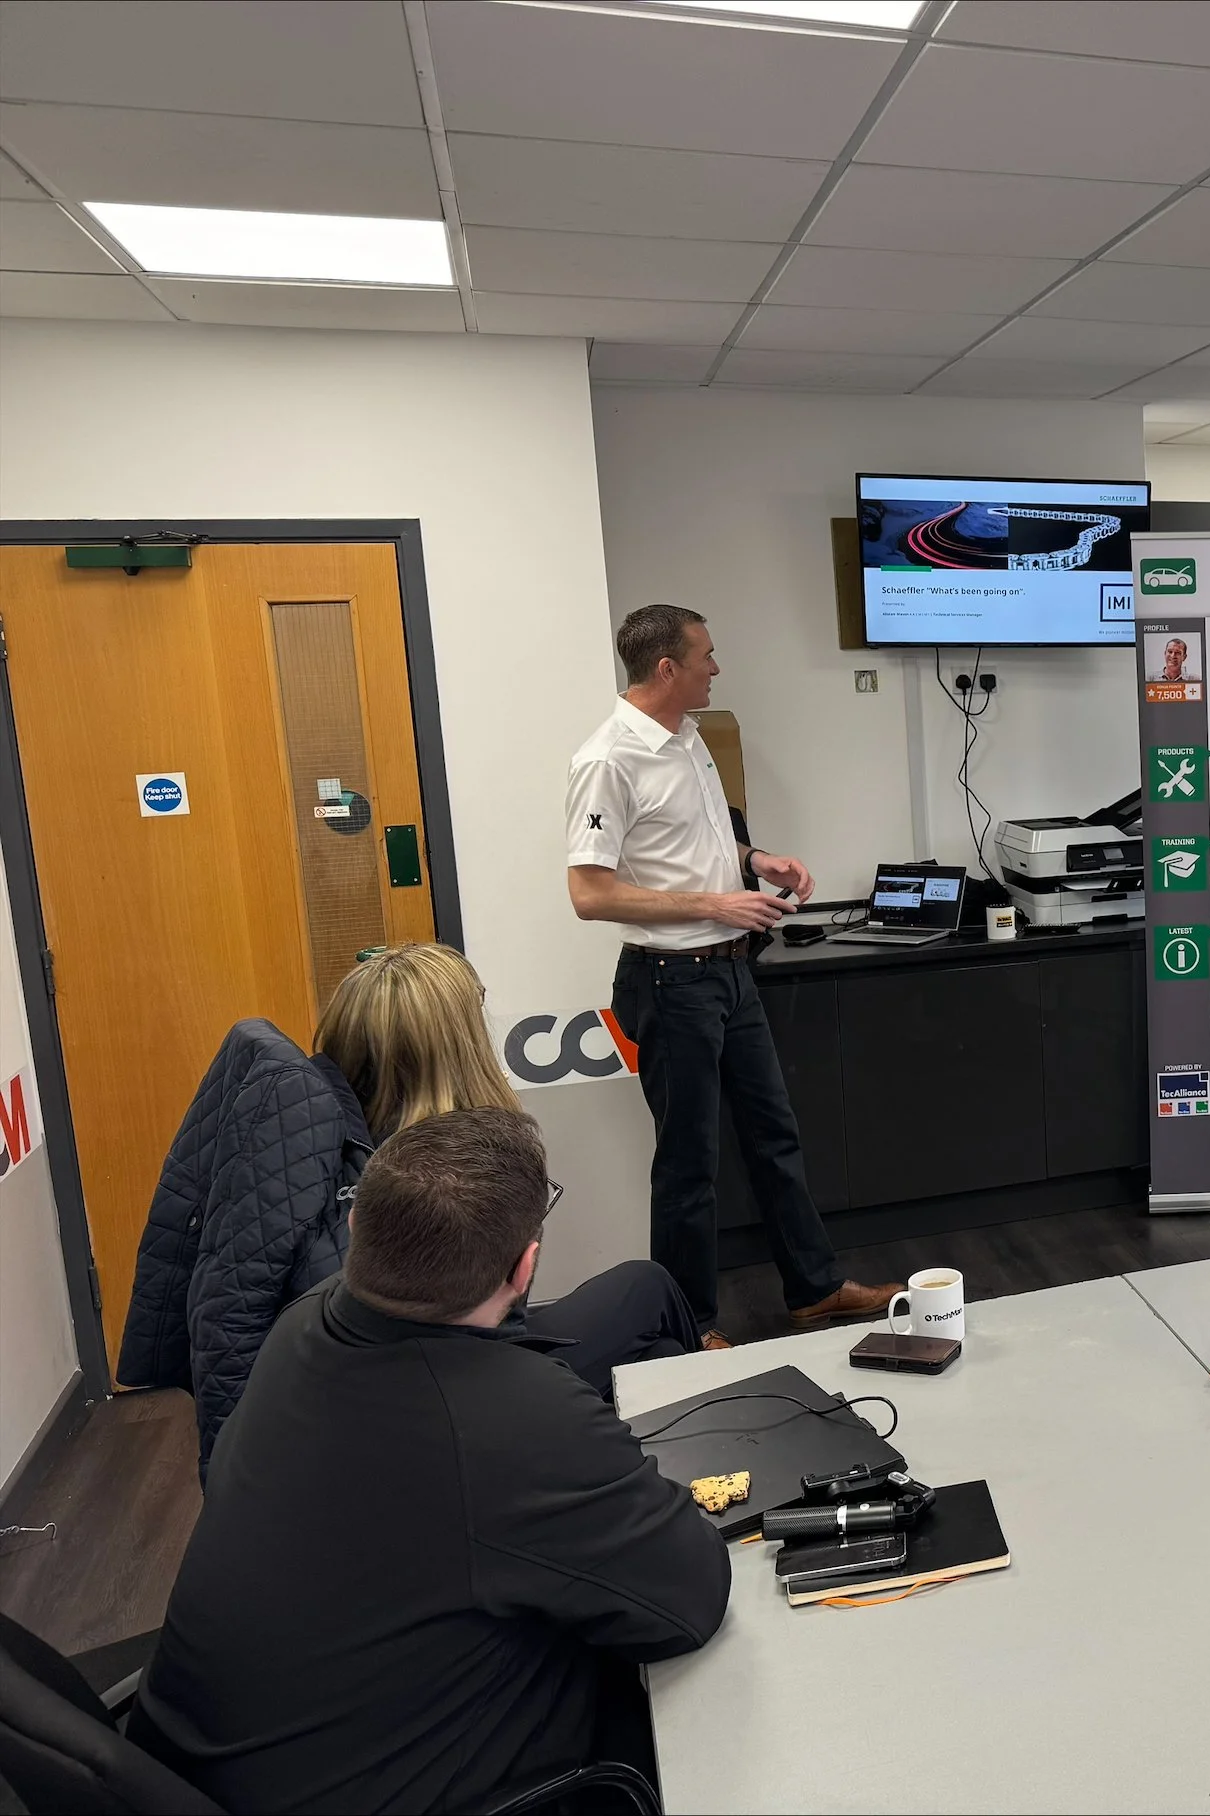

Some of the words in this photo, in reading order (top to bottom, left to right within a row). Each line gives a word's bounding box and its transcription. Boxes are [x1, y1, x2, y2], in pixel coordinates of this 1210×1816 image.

[881, 586, 925, 595] Schaeffler
[961, 587, 982, 595] been
[983, 588, 1007, 597] going
[1143, 624, 1170, 632] PROFILE
[1156, 690, 1183, 701] 7,500
[1157, 748, 1194, 756] PRODUCTS
[1161, 838, 1196, 846] TRAINING
[1168, 927, 1193, 935] LATEST
[1161, 1088, 1207, 1098] TecAlliance
